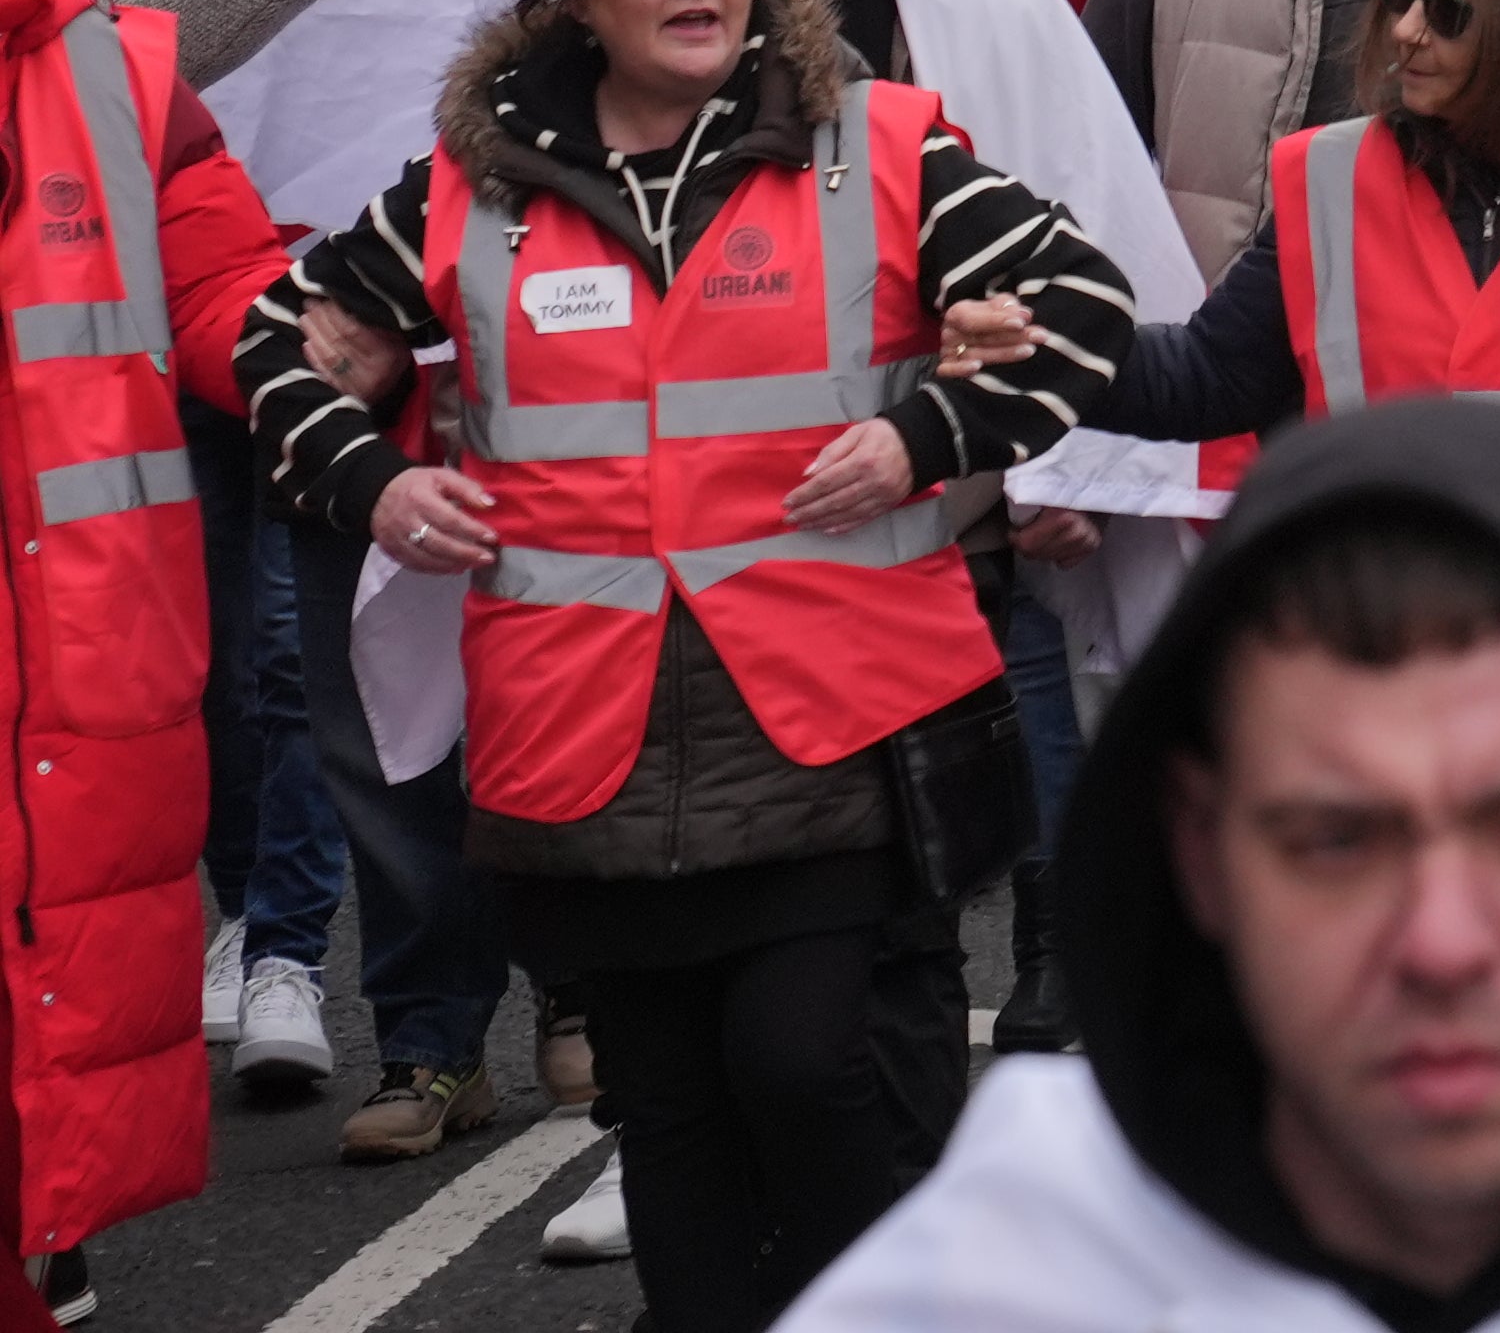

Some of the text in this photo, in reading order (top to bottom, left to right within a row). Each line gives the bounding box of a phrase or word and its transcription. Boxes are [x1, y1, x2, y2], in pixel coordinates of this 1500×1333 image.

[556, 283, 598, 298] I AM
[538, 299, 615, 320] TOMMY
